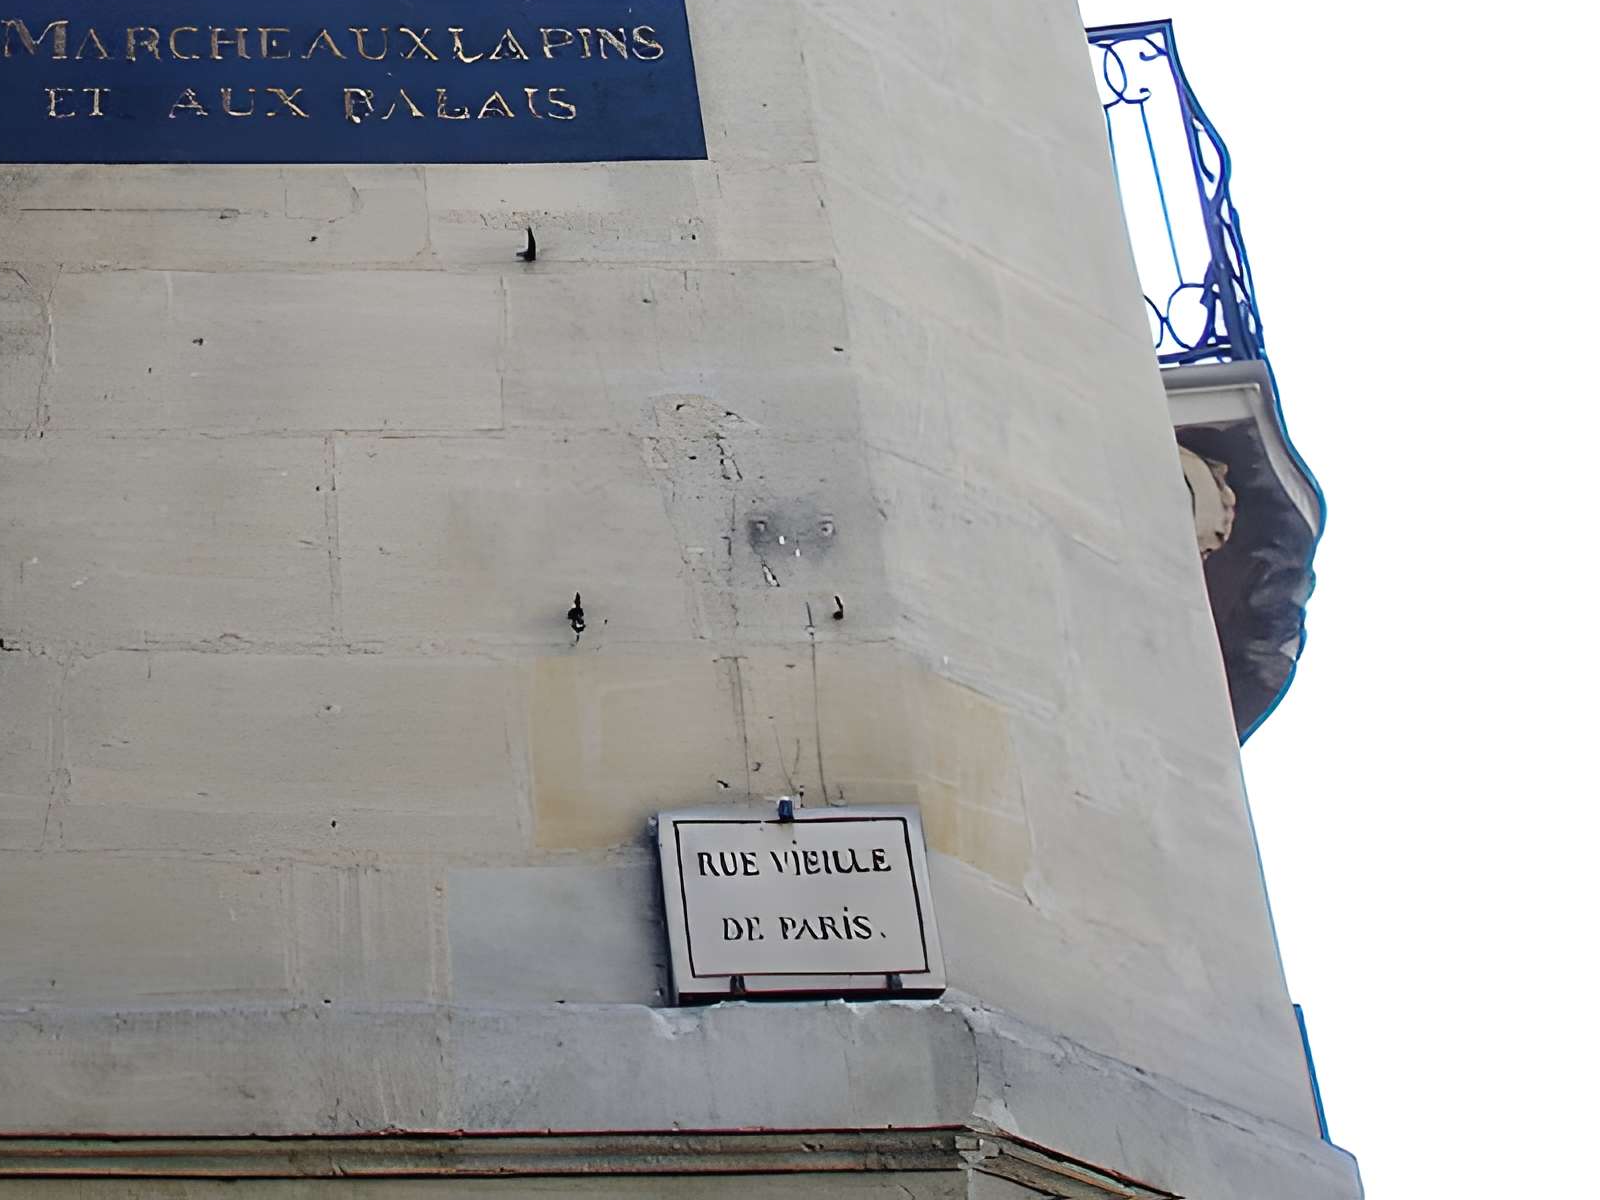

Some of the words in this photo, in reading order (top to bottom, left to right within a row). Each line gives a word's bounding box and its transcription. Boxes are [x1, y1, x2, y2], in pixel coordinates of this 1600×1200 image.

[43, 87, 112, 118] ET
[168, 87, 310, 119] AUX
[696, 850, 761, 877] RUE
[769, 840, 892, 876] VIEILLE
[722, 916, 765, 942] DE
